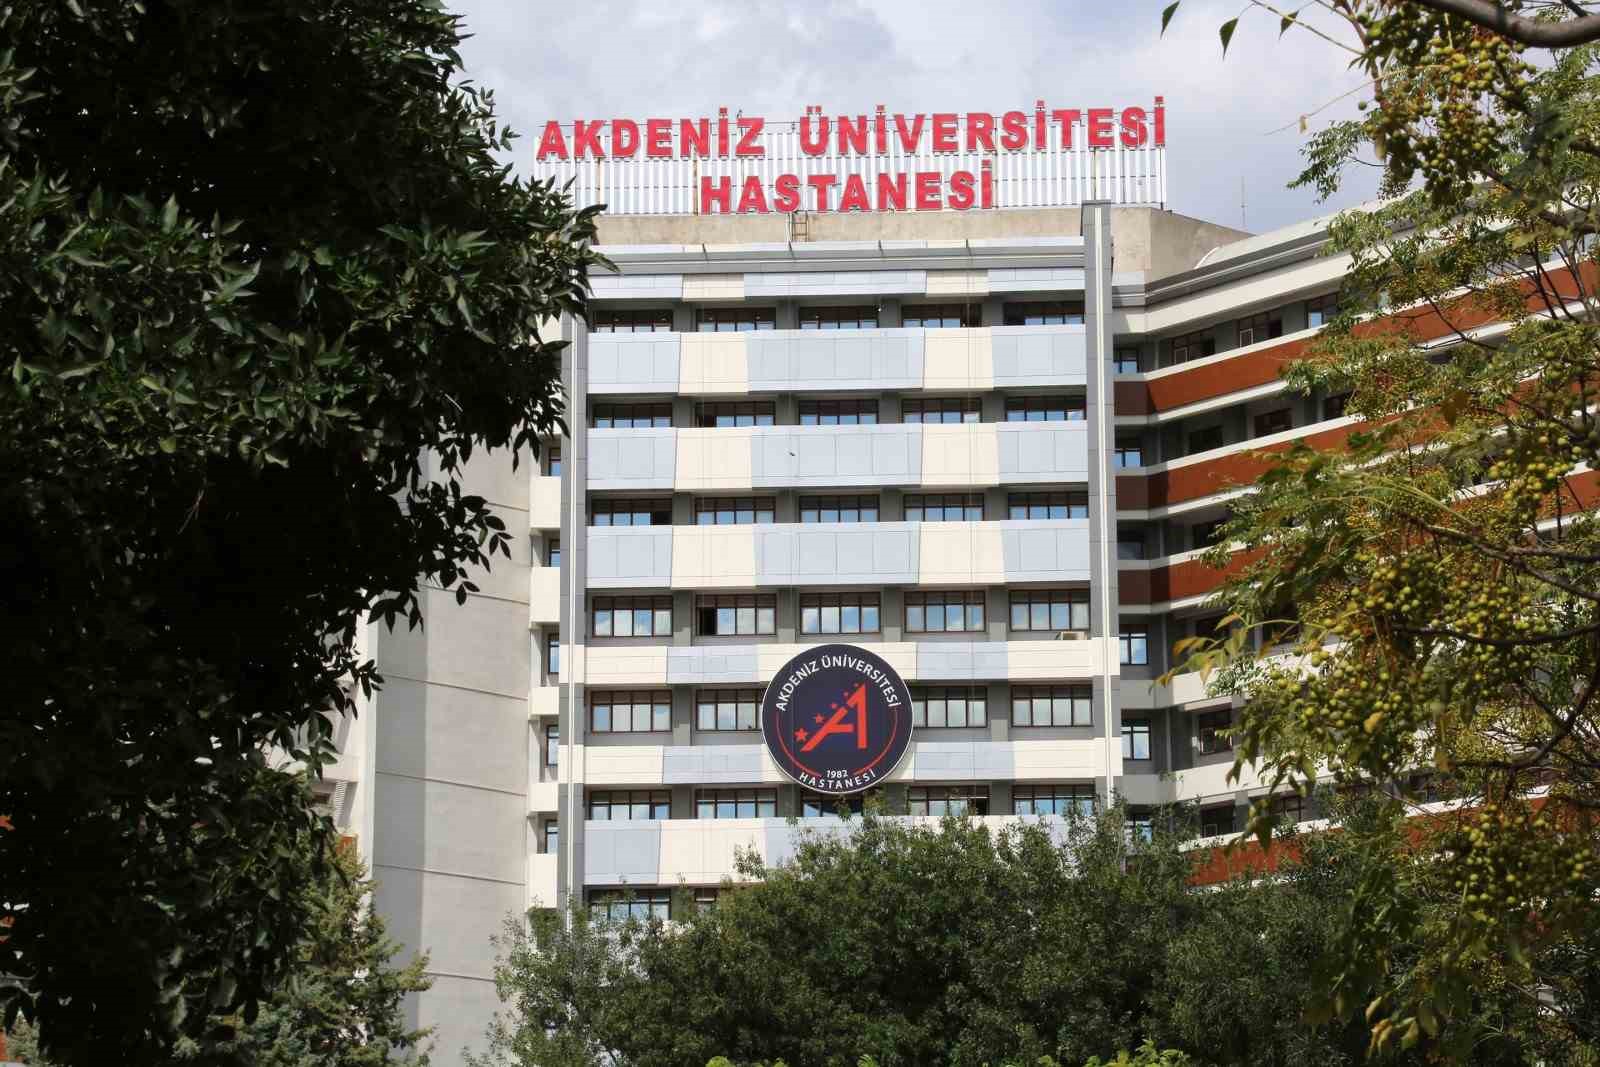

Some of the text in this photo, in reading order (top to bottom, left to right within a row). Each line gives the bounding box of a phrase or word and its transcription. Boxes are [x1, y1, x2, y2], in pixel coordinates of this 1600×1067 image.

[537, 95, 1166, 161] AKDENİZ ÜNİVERSİTESİ
[701, 159, 993, 215] HASTANESİ
[776, 654, 902, 712] AKDENİZ ÜNİVERSİTESİ
